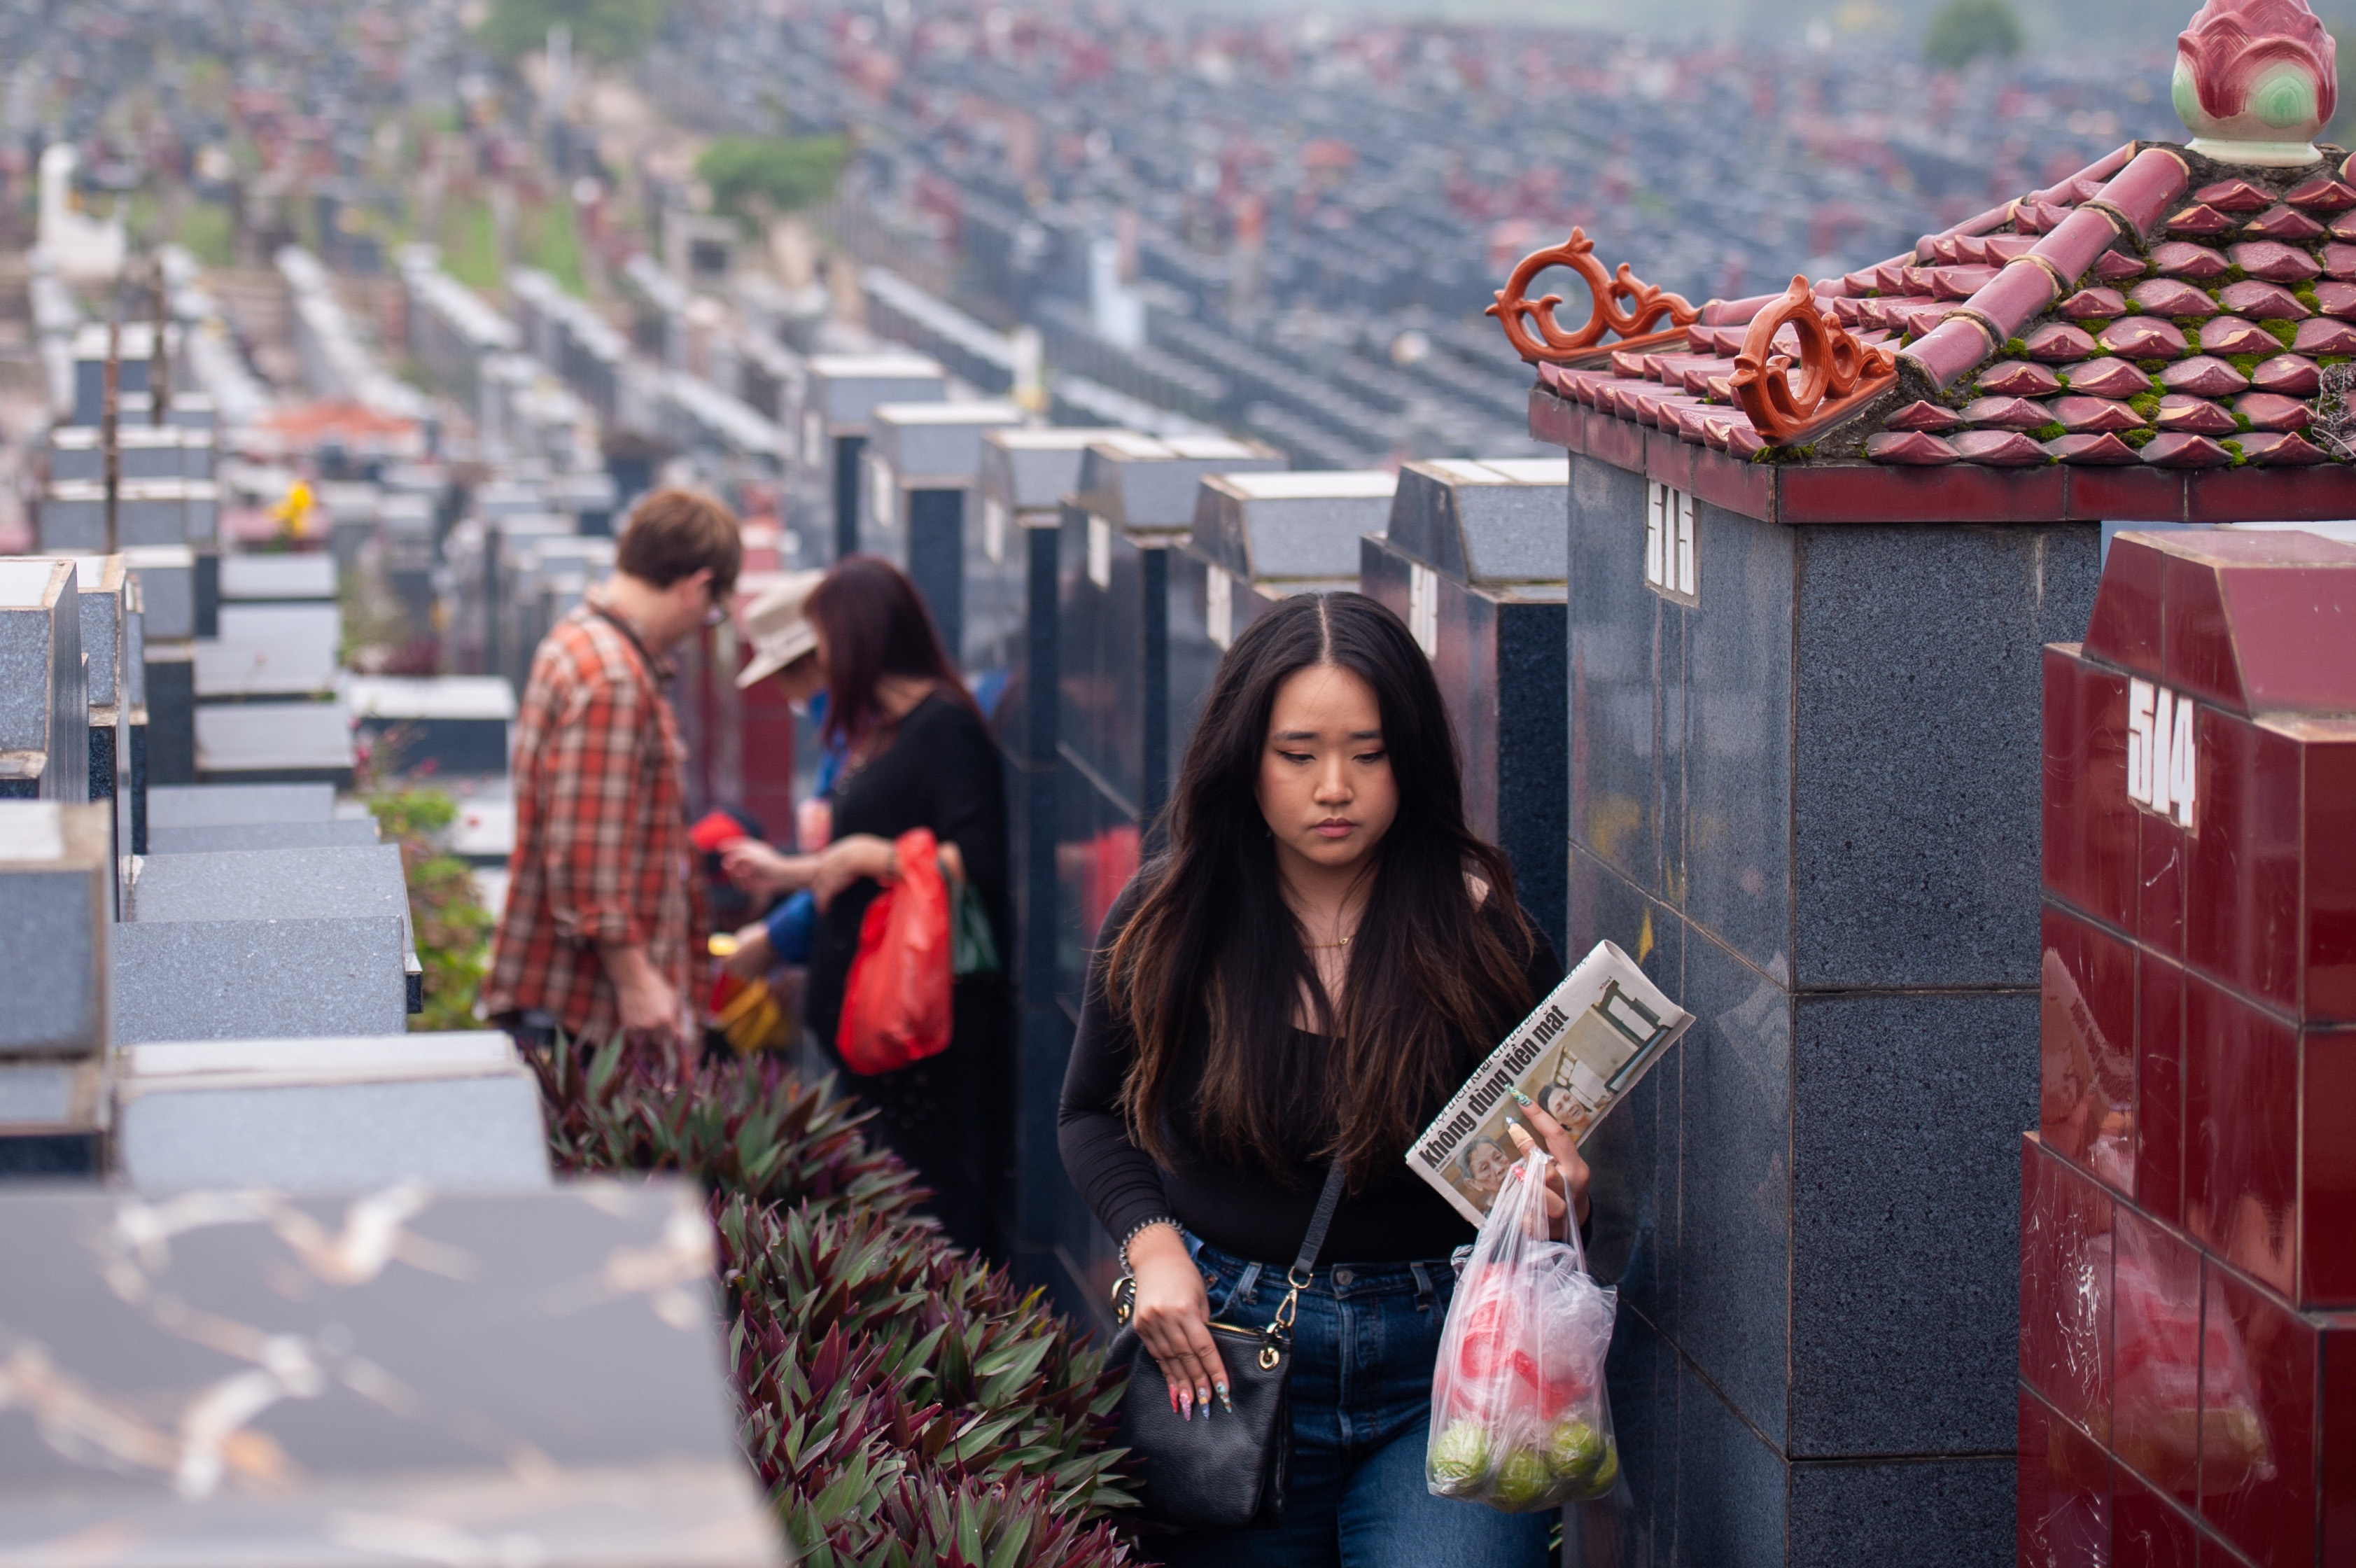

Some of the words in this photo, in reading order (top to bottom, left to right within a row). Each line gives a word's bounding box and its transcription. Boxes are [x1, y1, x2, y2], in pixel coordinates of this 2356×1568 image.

[1648, 479, 1694, 596] 515
[2128, 677, 2196, 827] 514
[1419, 1109, 1477, 1169] không
[1468, 1068, 1514, 1116] dùng
[1503, 1037, 1541, 1076] tiền
[1532, 1004, 1569, 1045] mặt
